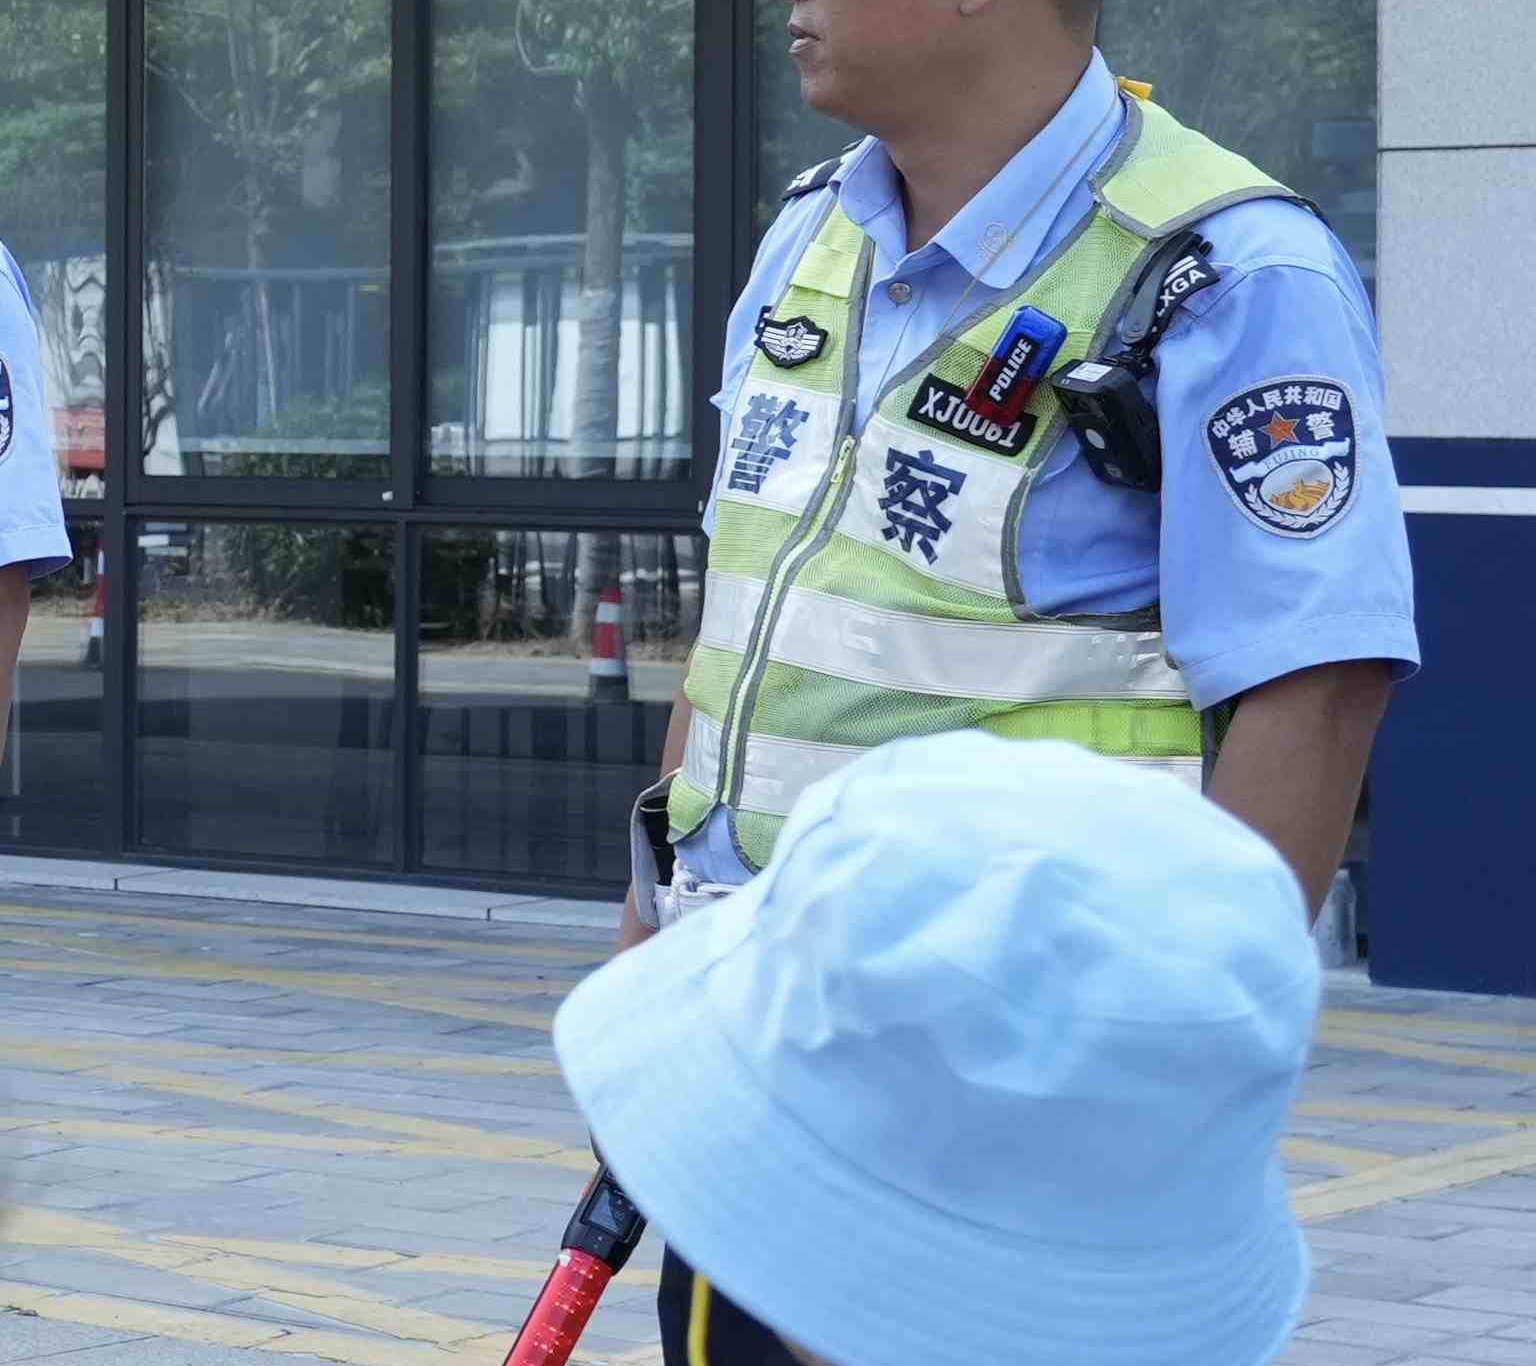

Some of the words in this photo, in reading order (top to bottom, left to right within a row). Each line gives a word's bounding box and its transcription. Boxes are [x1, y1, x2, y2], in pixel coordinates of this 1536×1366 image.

[989, 338, 1033, 402] POLICE
[1211, 385, 1343, 439] 中华人民共和国
